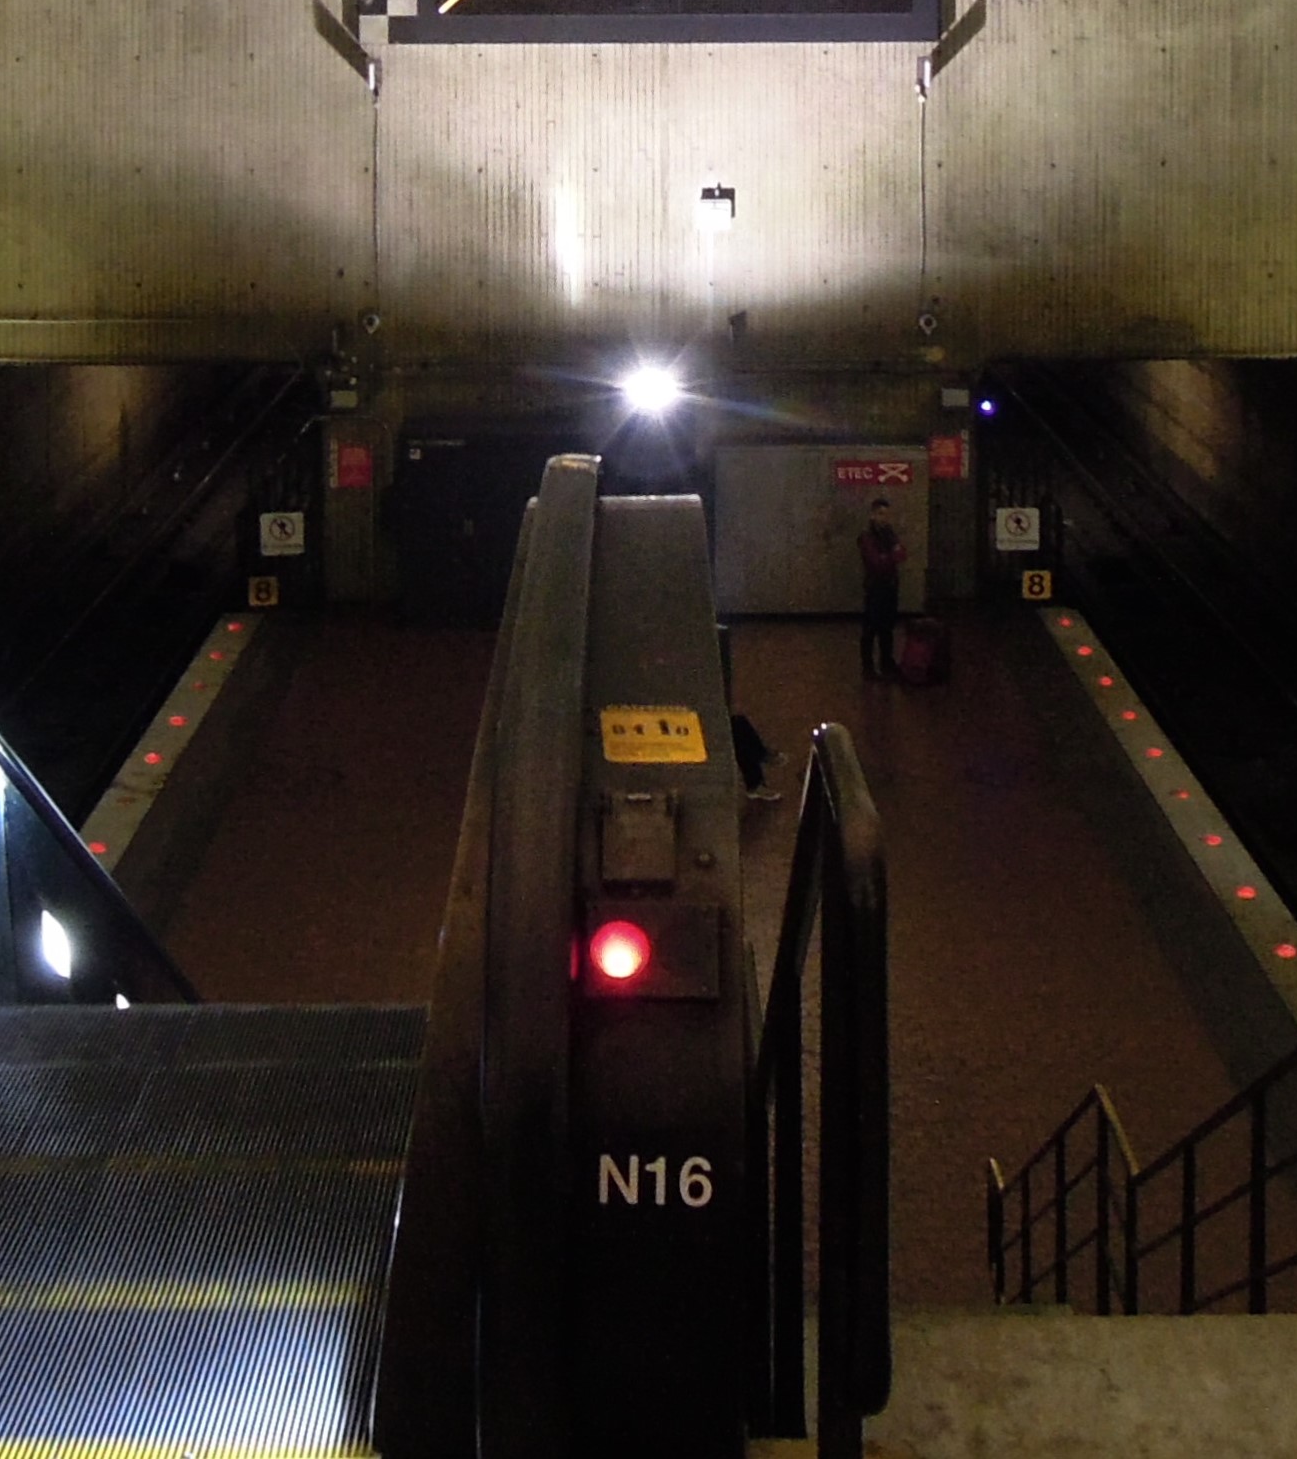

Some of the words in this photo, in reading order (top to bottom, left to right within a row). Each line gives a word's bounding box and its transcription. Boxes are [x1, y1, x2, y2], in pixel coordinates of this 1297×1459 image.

[836, 466, 873, 479] ETEC
[254, 580, 271, 602] 8
[1028, 573, 1045, 597] 8
[598, 1153, 713, 1208] N16
